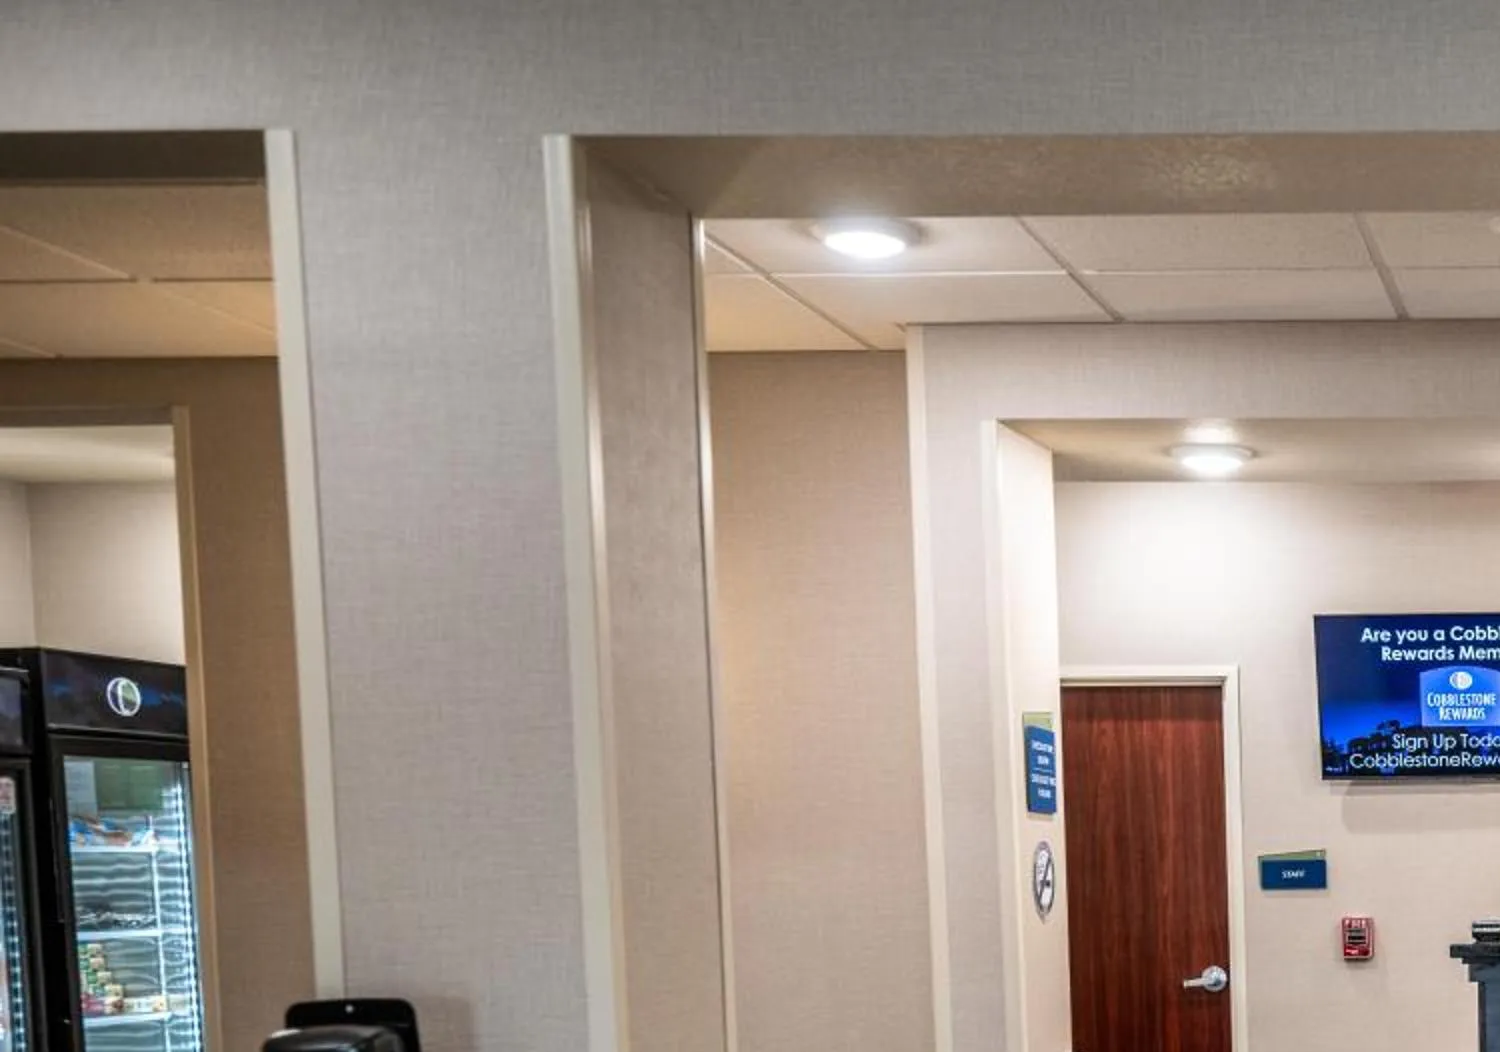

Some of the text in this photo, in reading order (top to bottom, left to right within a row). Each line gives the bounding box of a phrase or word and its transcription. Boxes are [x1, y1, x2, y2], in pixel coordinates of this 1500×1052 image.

[1361, 627, 1391, 643] Are
[1395, 629, 1429, 645] you
[1433, 631, 1445, 642] a
[1381, 645, 1455, 662] Rewards
[1426, 692, 1497, 707] COBBLESTONE
[1439, 706, 1486, 721] REWARDS
[1391, 734, 1428, 752] Sign
[1432, 734, 1457, 751] Up
